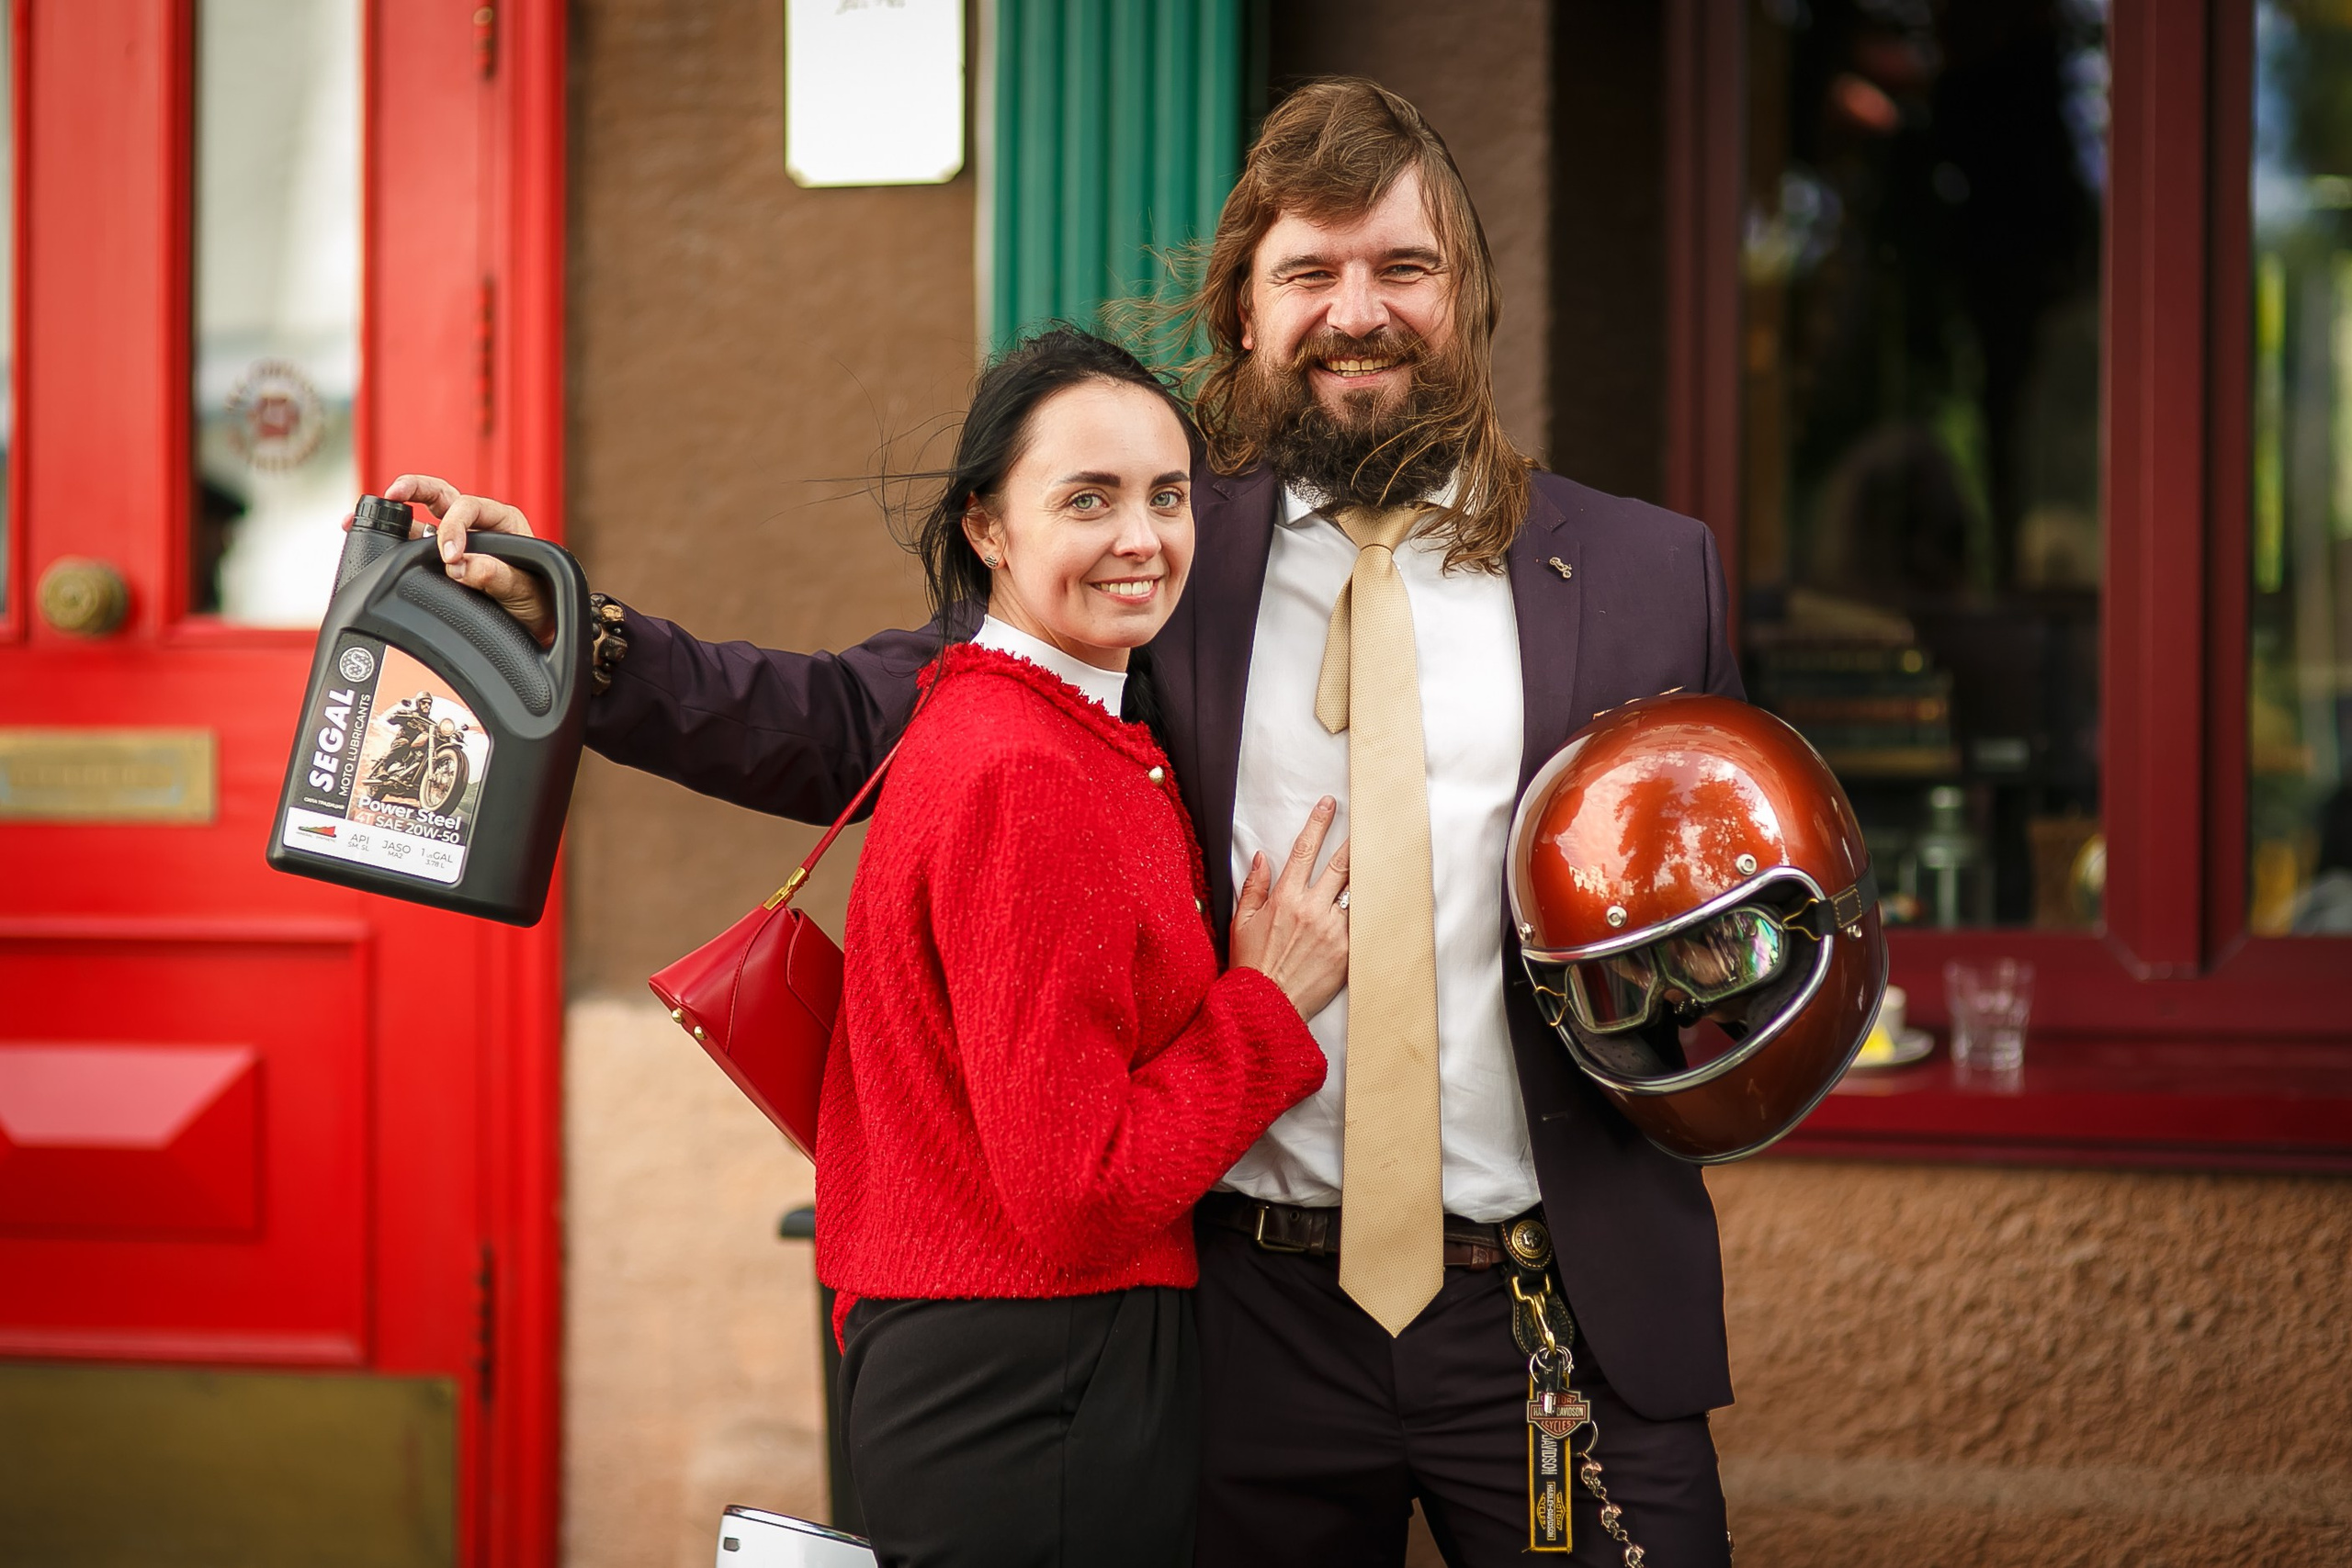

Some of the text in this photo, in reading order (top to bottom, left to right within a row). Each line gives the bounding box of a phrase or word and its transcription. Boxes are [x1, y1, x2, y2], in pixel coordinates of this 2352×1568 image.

[309, 689, 356, 793] SEGAL
[338, 694, 370, 796] MOTO LUBRICANTS
[357, 795, 462, 830] Power Steel
[354, 811, 459, 844] 4T SAE 20W-50
[350, 833, 369, 844] API
[382, 840, 412, 854] JASO
[388, 851, 403, 860] MA2
[421, 848, 425, 856] 1
[433, 852, 453, 863] GAL
[1544, 1420, 1572, 1433] CYCLES
